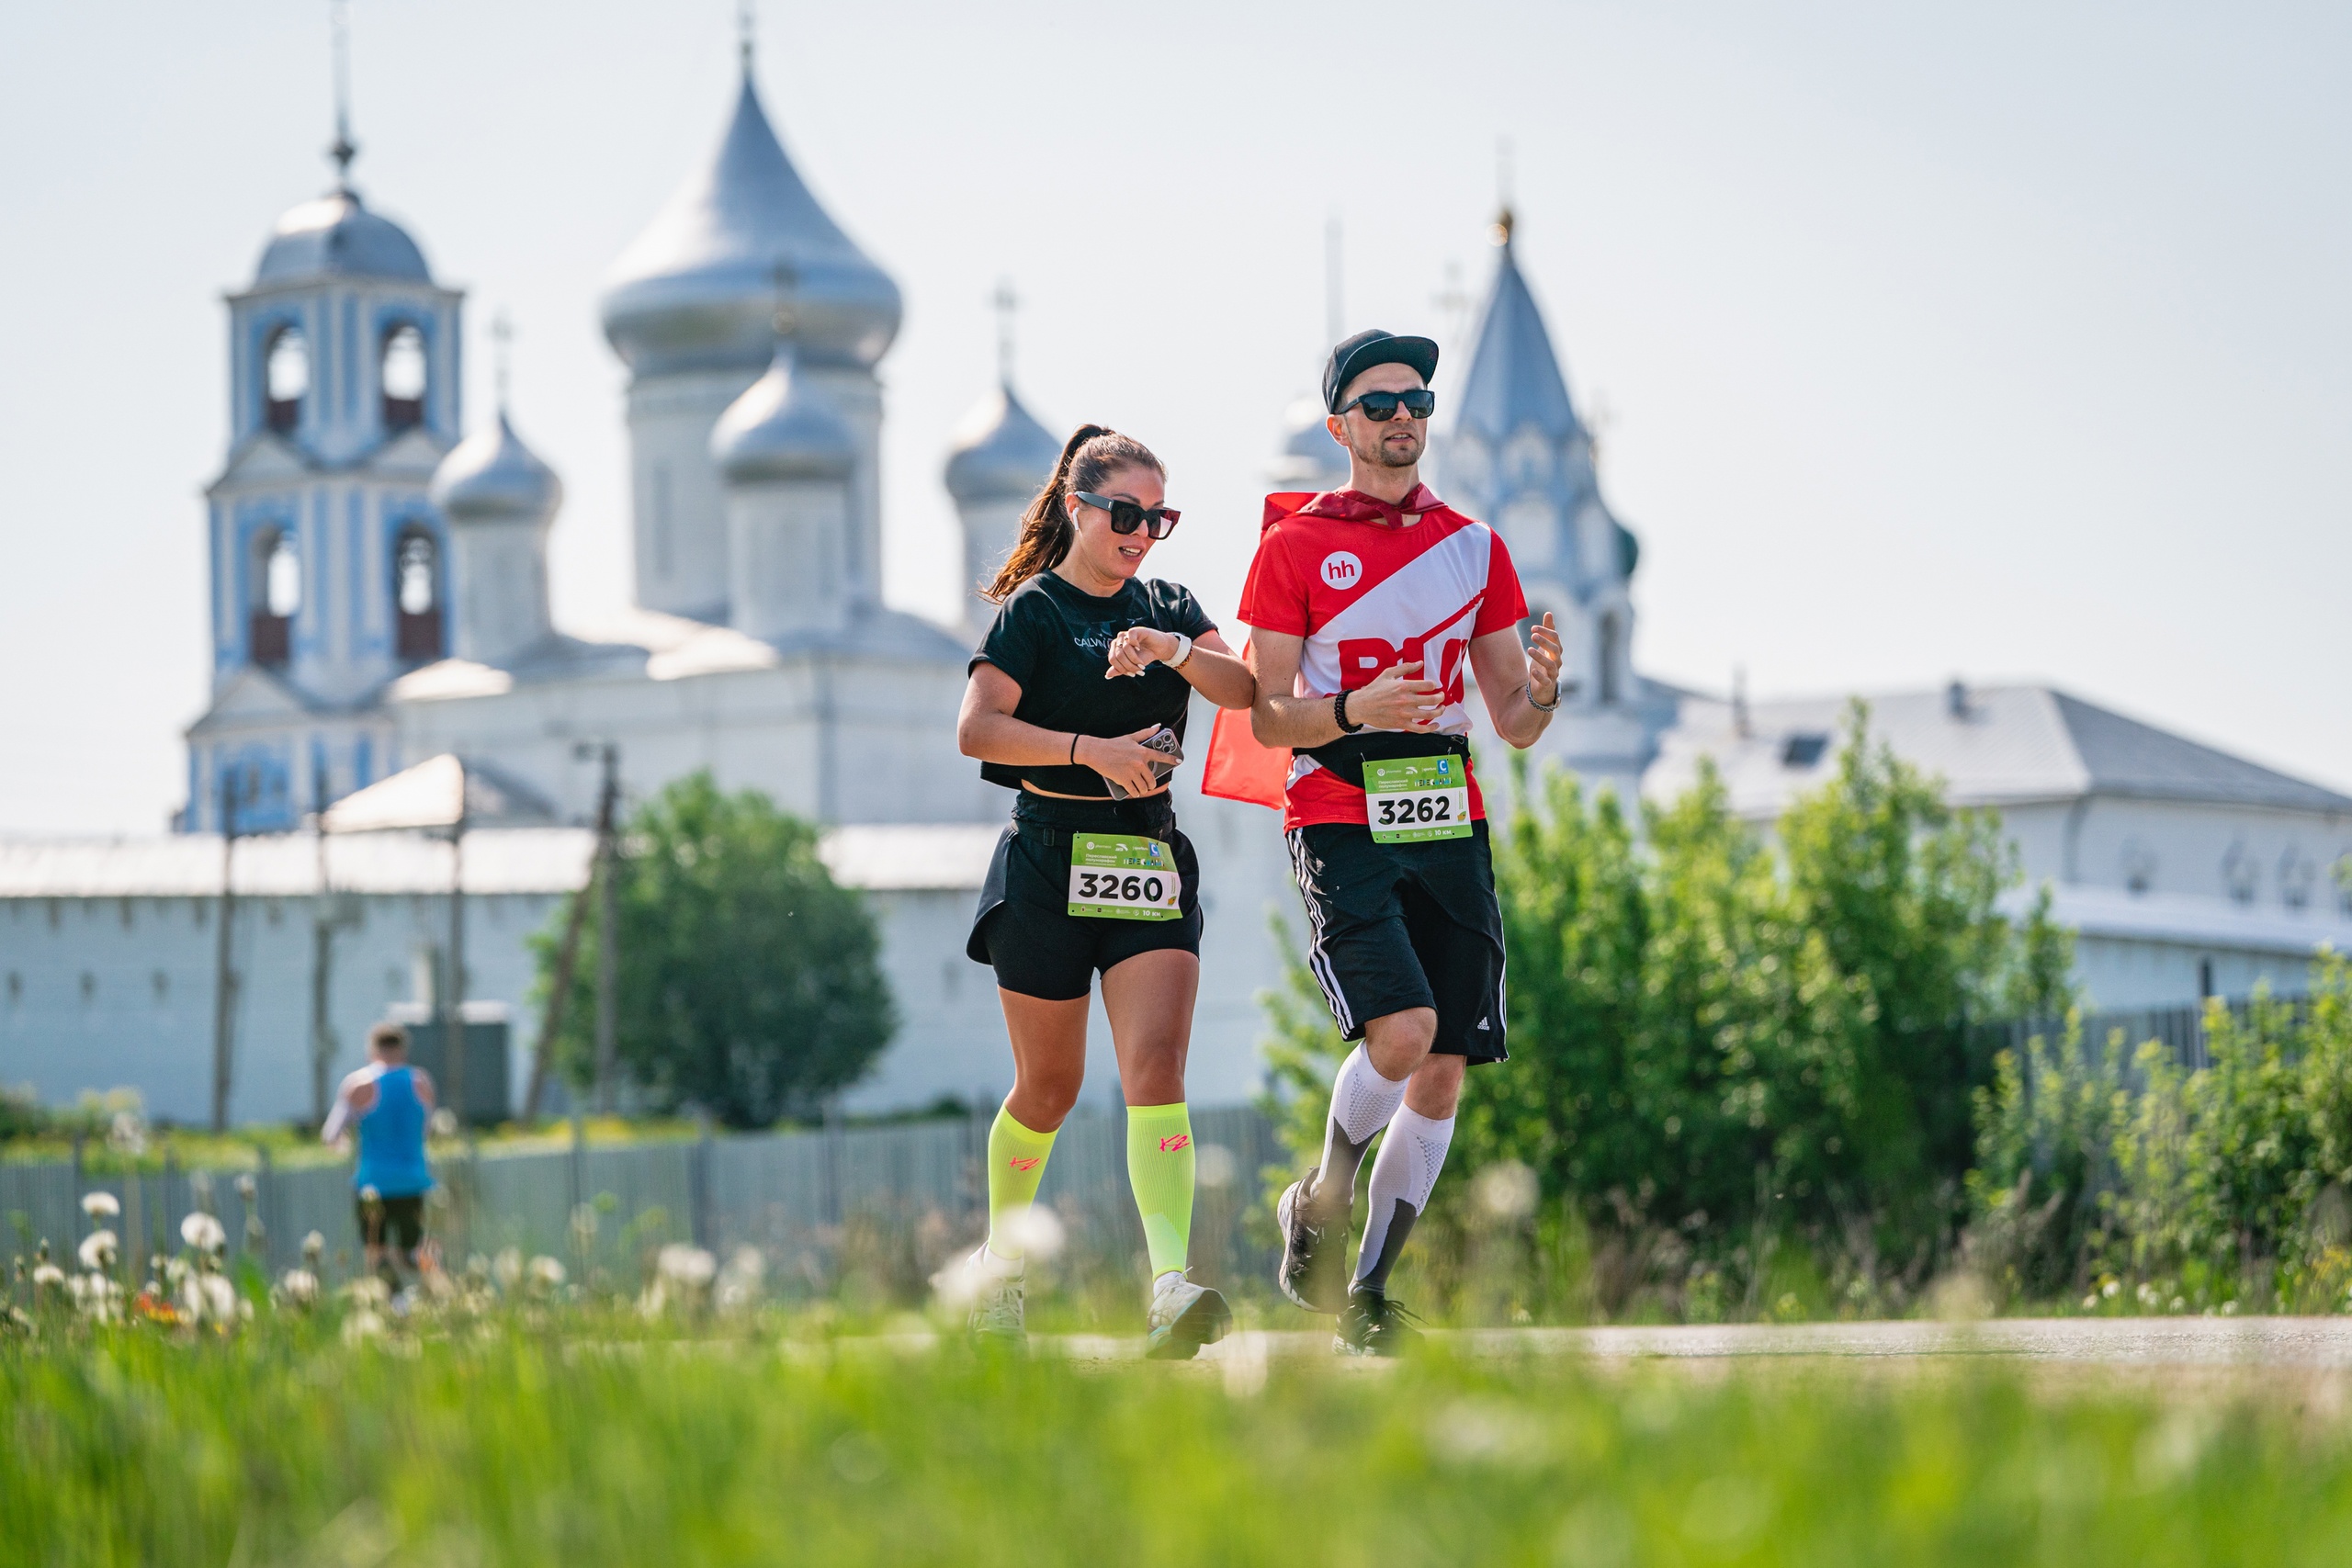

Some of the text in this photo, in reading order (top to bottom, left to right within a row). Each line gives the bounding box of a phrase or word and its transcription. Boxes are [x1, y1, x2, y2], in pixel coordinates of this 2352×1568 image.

[1328, 559, 1355, 581] hh
[1378, 795, 1450, 826] 3262
[1078, 873, 1163, 902] 3260
